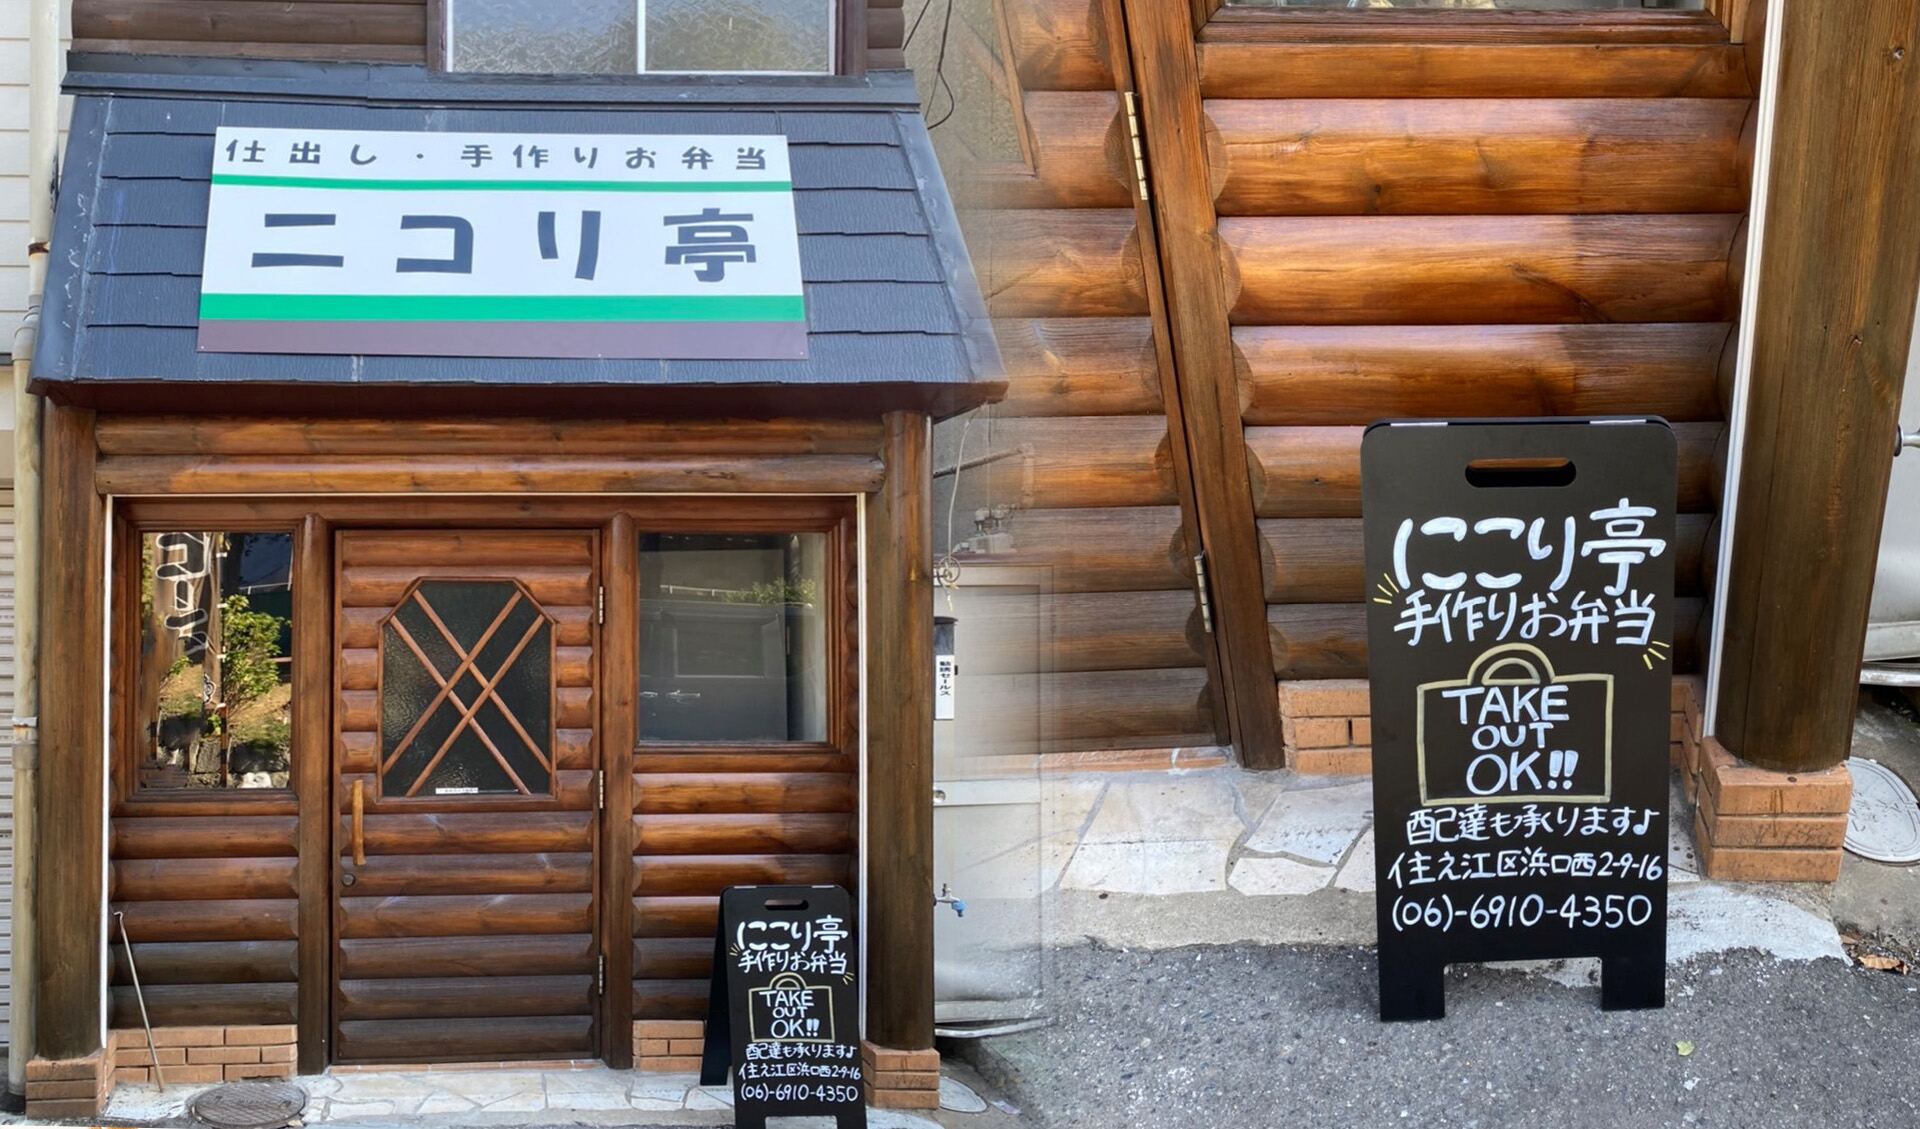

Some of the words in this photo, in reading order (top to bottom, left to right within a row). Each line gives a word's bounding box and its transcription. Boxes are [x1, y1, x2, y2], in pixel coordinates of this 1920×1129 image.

[225, 139, 766, 170] 仕出し・手作りお弁当
[251, 208, 757, 283] ニコリ亭
[1393, 497, 1667, 596] にこり亭
[1393, 589, 1656, 646] 手作りお弁当
[1441, 684, 1570, 725] TAKE
[1471, 722, 1554, 750] OUT
[1466, 750, 1579, 796] OK!!
[1392, 894, 1652, 932] (06)-6910-4350
[736, 914, 849, 955] にこり亭
[737, 950, 848, 975] 手作りお弁当
[759, 989, 814, 1008] TAKE
[772, 1006, 808, 1018] OUT
[770, 1018, 820, 1039] OK!!
[740, 1082, 859, 1103] (06)-6910-4350
